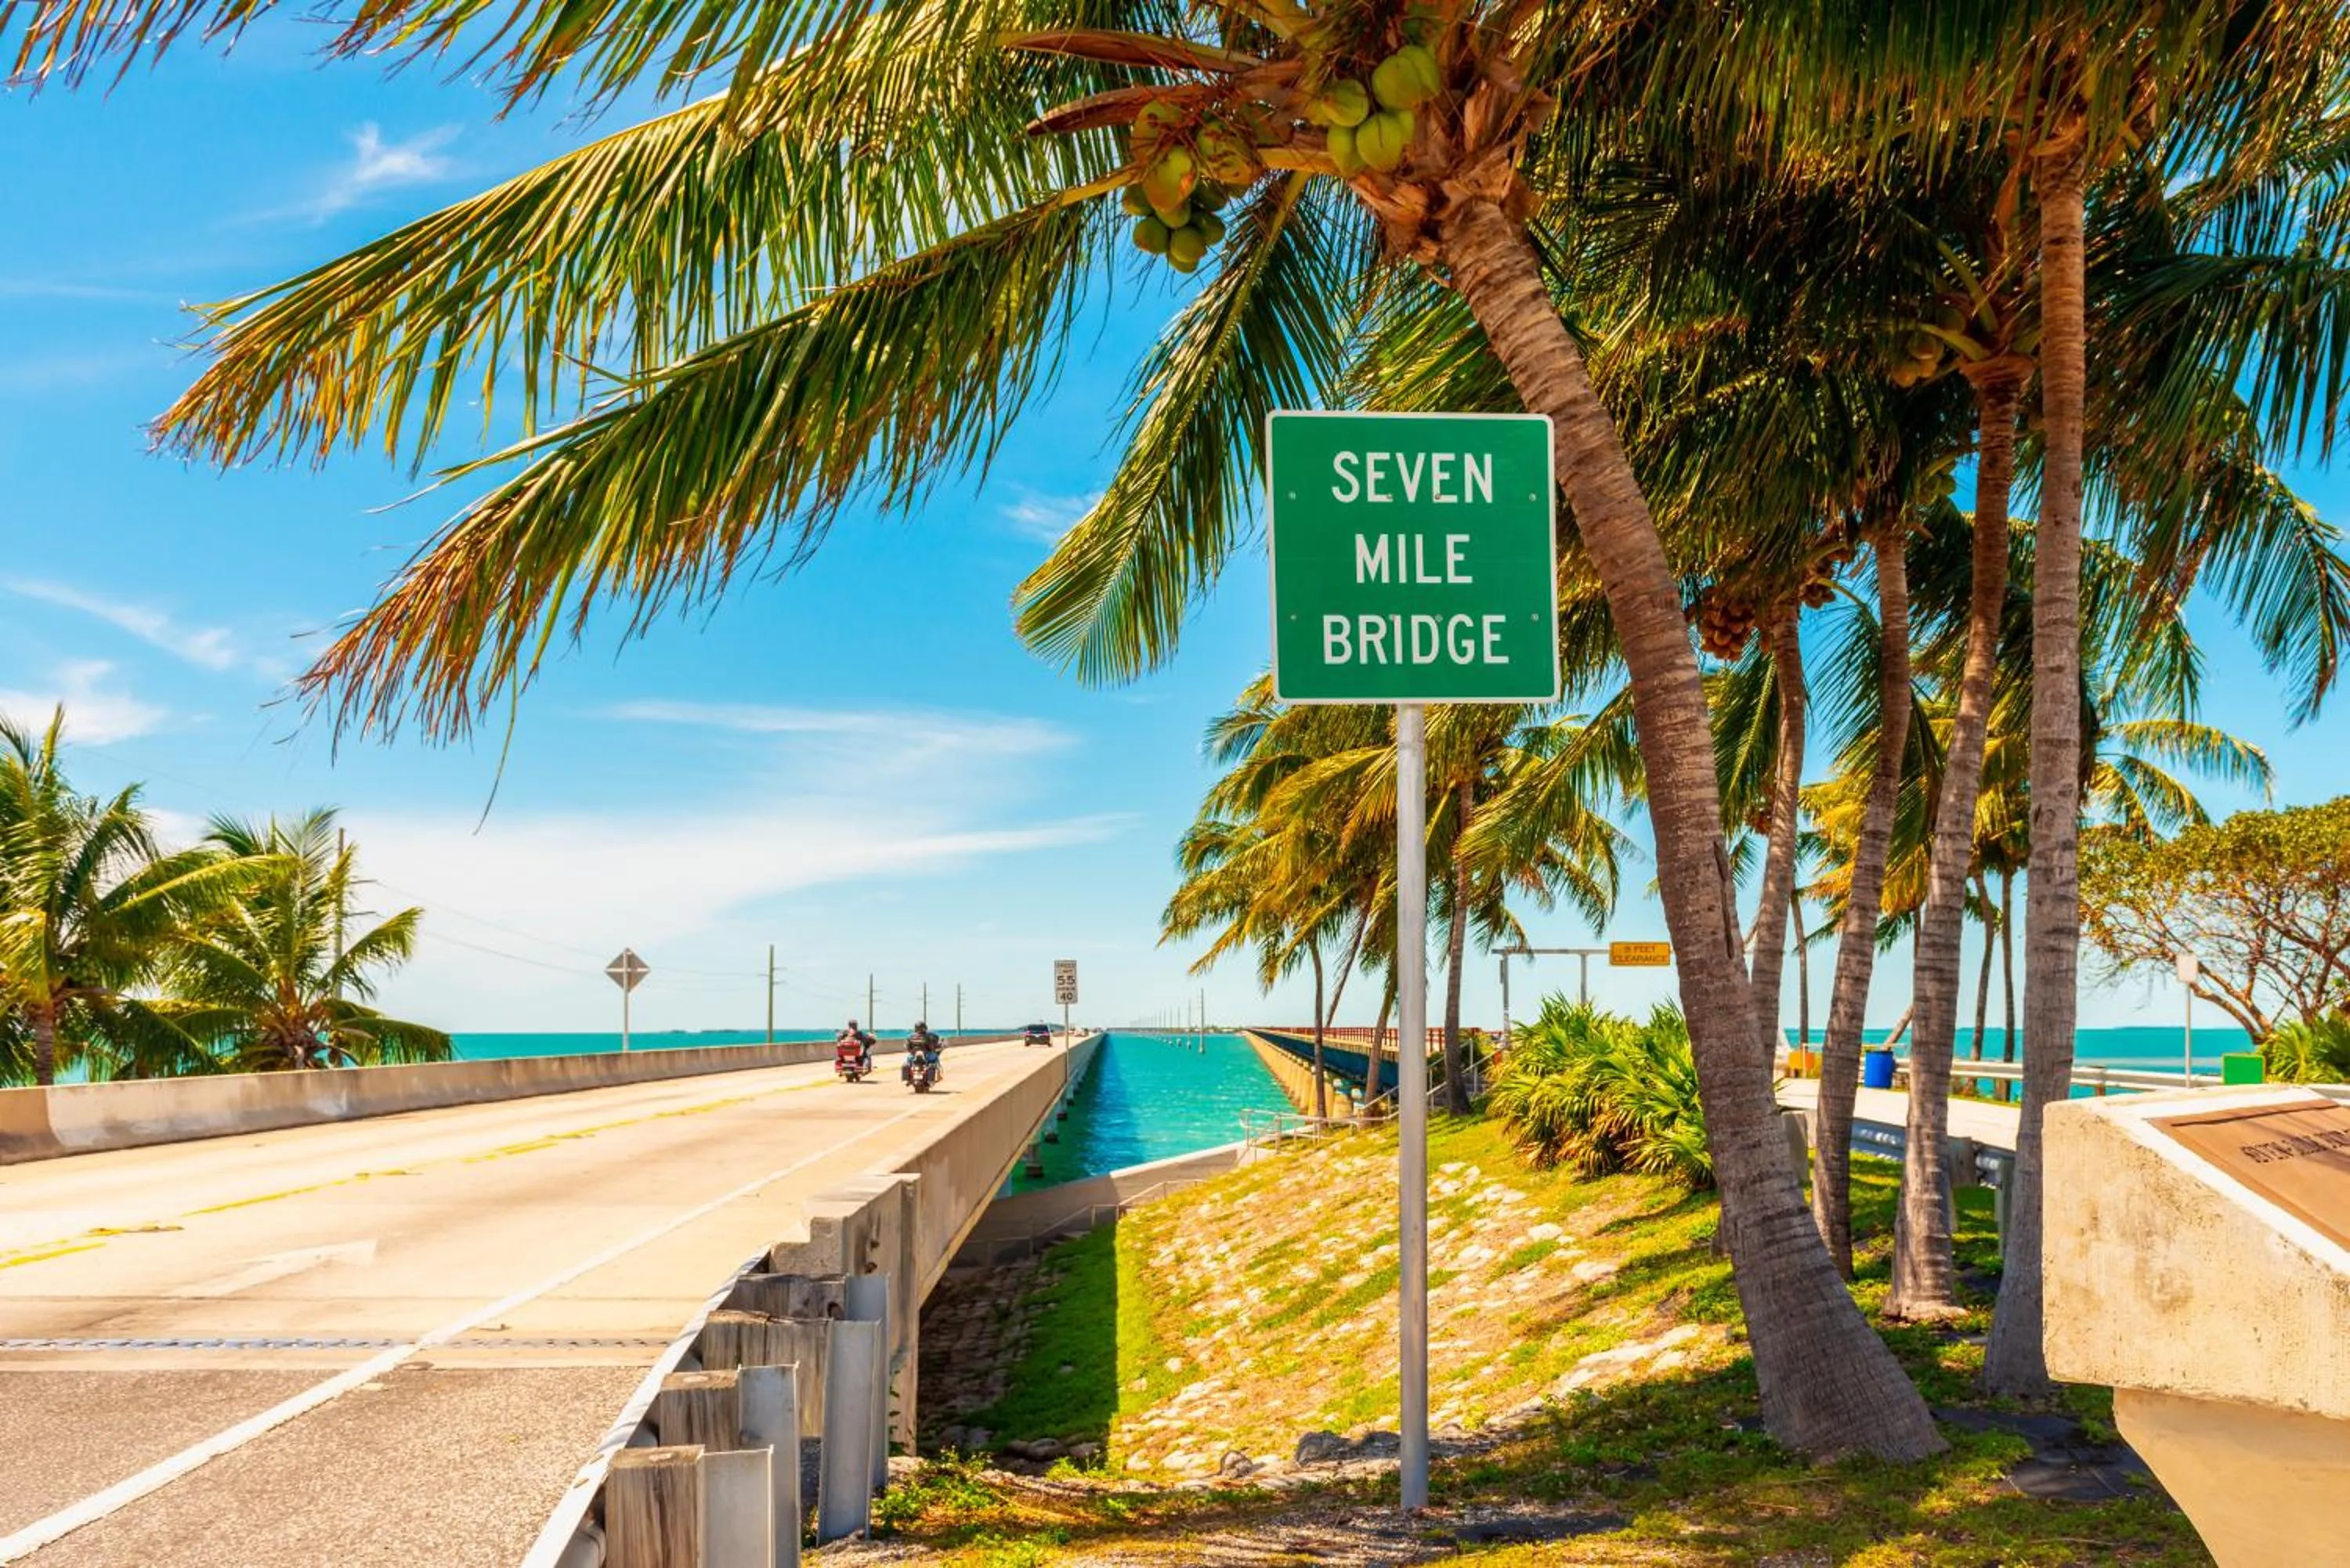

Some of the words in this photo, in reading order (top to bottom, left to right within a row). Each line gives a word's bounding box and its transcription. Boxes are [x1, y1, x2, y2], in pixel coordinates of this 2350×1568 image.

[1332, 451, 1492, 503] SEVEN
[1355, 533, 1473, 583] MILE
[1323, 613, 1509, 665] BRIDGE
[1613, 954, 1668, 963] CLEARANCE
[1057, 975, 1076, 985] 55
[1060, 992, 1073, 1001] 40
